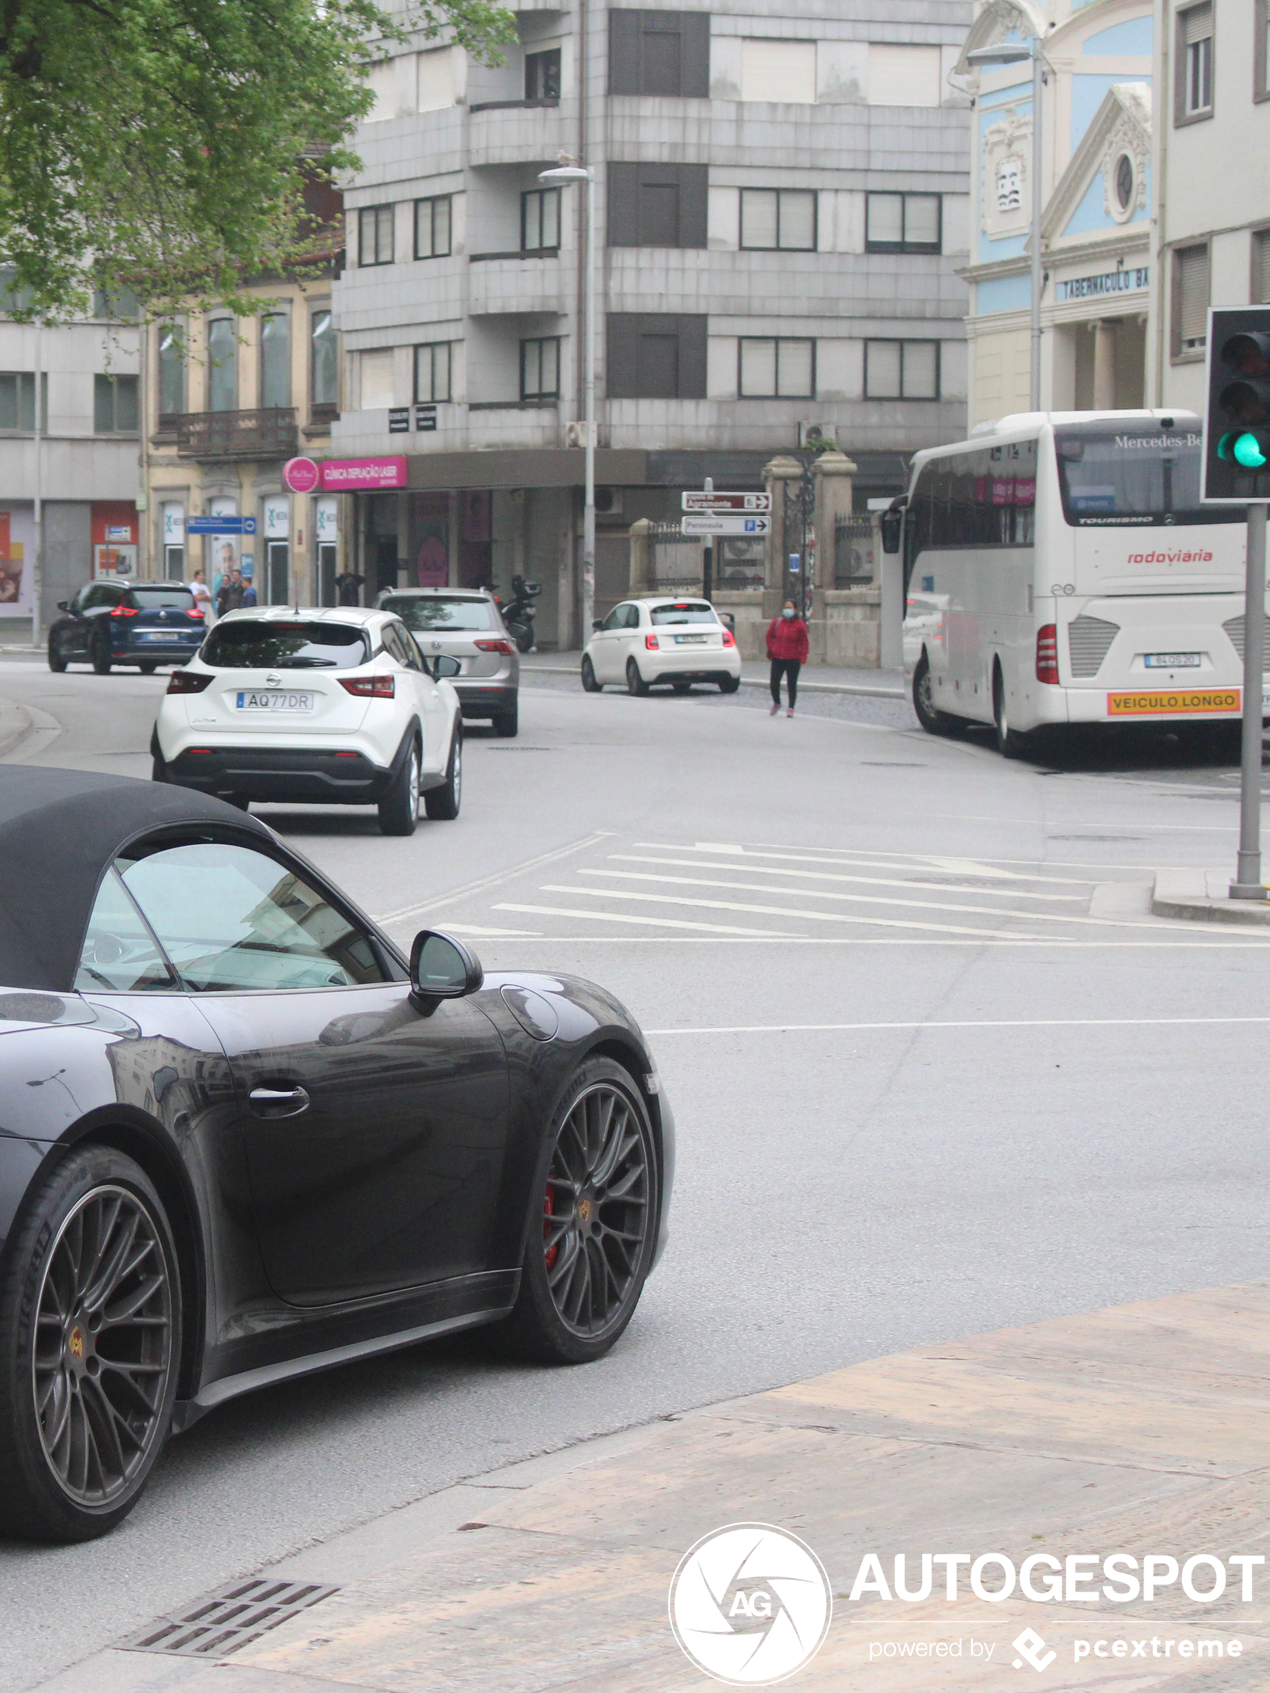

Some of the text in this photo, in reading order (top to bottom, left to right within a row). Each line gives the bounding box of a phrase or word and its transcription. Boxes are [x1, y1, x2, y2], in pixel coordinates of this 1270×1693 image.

[348, 464, 379, 480] DEPILAÇÃO
[380, 465, 397, 477] LASER
[1078, 516, 1154, 525] TOURISMO
[1113, 695, 1235, 709] VEICULO LONGO
